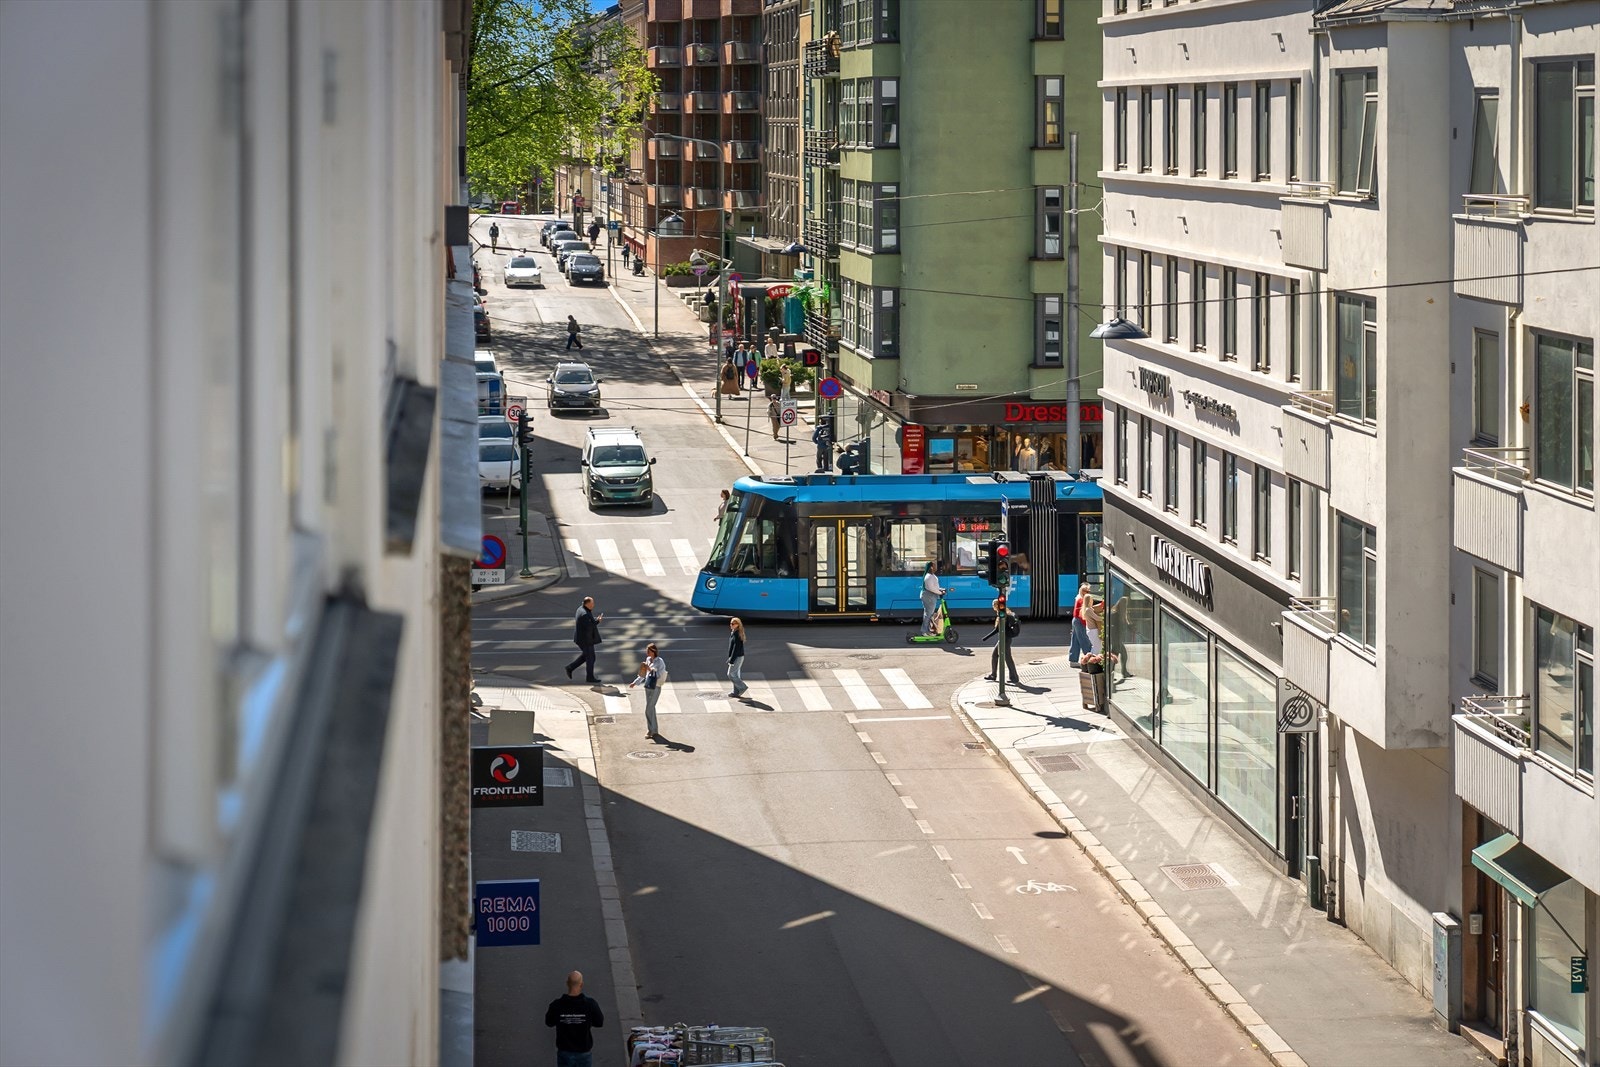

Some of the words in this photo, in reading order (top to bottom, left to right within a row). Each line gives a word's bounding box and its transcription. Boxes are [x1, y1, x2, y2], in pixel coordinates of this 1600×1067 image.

[806, 352, 818, 364] D
[511, 409, 520, 417] 30
[785, 412, 792, 420] 30
[958, 523, 966, 531] 19
[1150, 534, 1209, 596] LAGERHAUS
[473, 786, 537, 796] FRONTLINE
[480, 896, 536, 913] REMA
[487, 916, 530, 933] 1000
